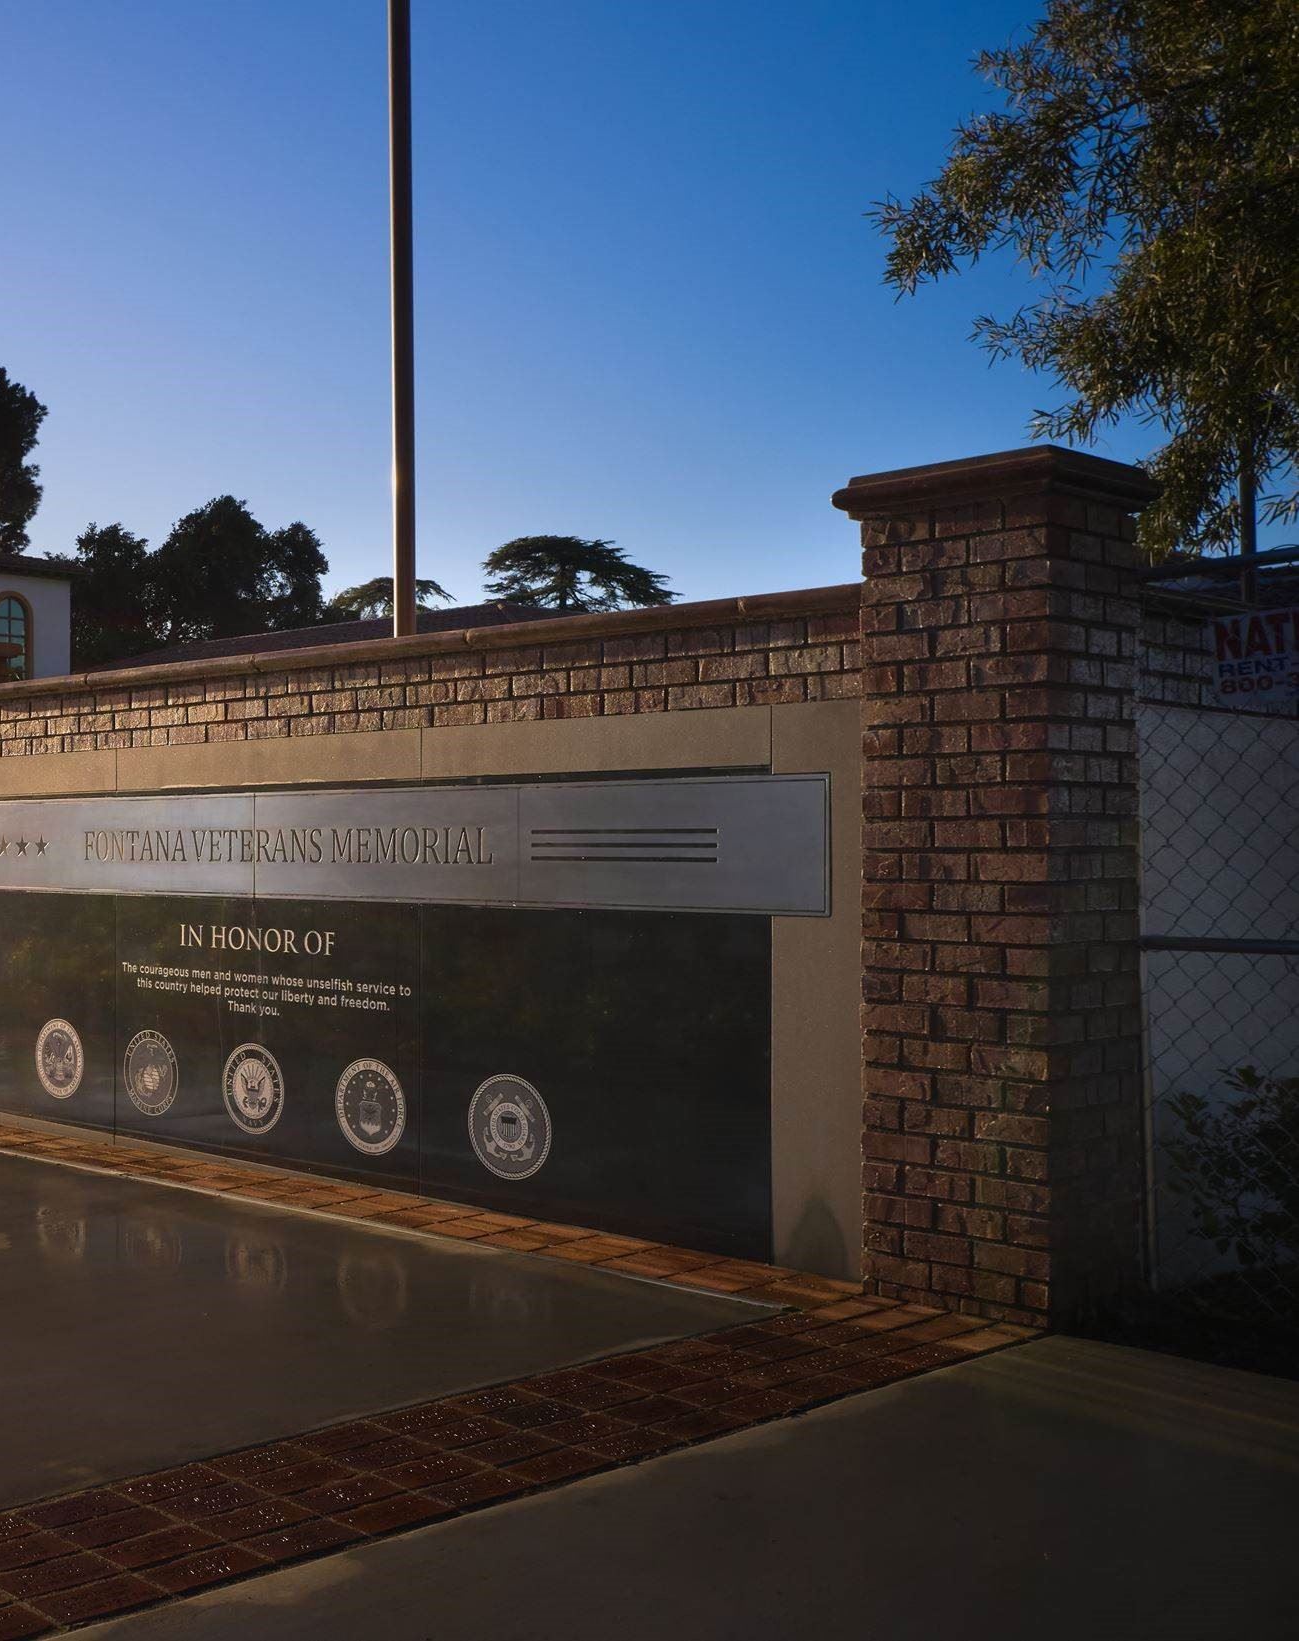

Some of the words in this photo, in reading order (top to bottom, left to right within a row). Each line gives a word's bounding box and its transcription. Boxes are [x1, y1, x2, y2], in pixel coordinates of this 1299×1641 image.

[84, 830, 186, 863] FONTANA
[191, 828, 324, 864] VETERANS
[331, 826, 493, 866] MEMORIAL
[179, 924, 204, 947] IN
[211, 925, 299, 954] HONOR
[304, 930, 335, 956] OF
[122, 962, 137, 973] The
[139, 965, 189, 980] courageous
[191, 968, 212, 980] men
[213, 969, 232, 981] and
[234, 973, 269, 985] women
[271, 974, 304, 987] whose
[306, 976, 353, 992] unselfish
[356, 982, 396, 995] service
[399, 985, 412, 997] to
[137, 977, 153, 989] this
[154, 981, 189, 995] country
[190, 982, 222, 996] helped
[224, 985, 259, 999] protect
[262, 989, 279, 1000] our
[281, 989, 314, 1006] liberty
[317, 992, 338, 1006] and
[340, 995, 391, 1011] freedom.
[228, 1000, 257, 1014] Thank
[259, 1004, 280, 1017] you.
[126, 1031, 150, 1057] UNITED
[154, 1033, 174, 1063] STATES
[227, 1052, 246, 1096] UNITED
[262, 1055, 280, 1102] STATES
[337, 1064, 362, 1119] DEPARTMENT
[363, 1061, 372, 1069] OF
[375, 1063, 390, 1077] THE
[389, 1078, 400, 1093] AIR
[154, 1096, 173, 1113] CORPS
